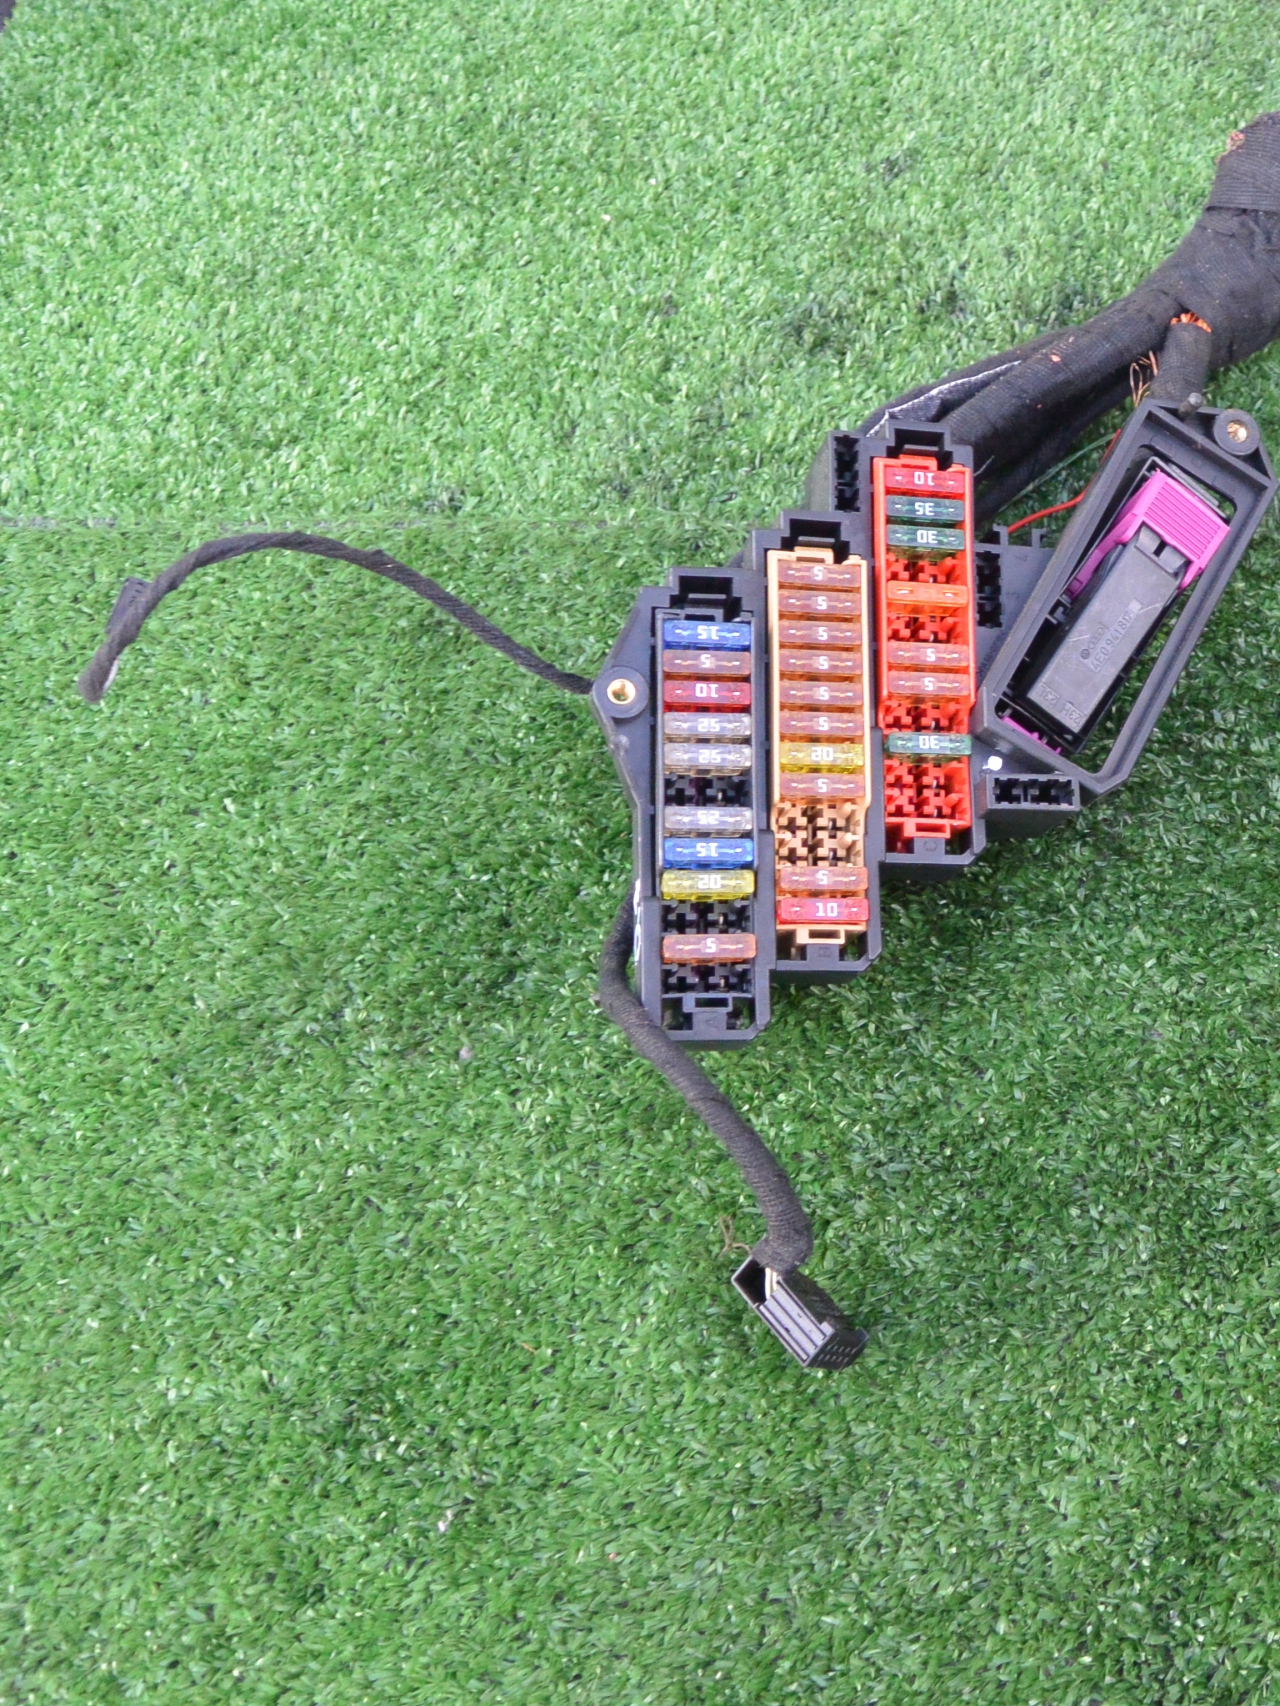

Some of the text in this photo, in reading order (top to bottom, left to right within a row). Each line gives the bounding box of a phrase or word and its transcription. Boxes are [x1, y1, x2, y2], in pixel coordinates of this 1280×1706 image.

[914, 472, 934, 485] 10
[915, 502, 934, 515] 35
[917, 530, 938, 543] 30
[813, 566, 823, 581] 5
[816, 596, 827, 610] 5
[697, 626, 719, 639] 15
[817, 627, 828, 640] 5
[700, 654, 711, 668] 5
[926, 648, 935, 661] 5
[818, 656, 829, 669] 5
[695, 683, 718, 698] 10
[924, 677, 934, 691] 5
[818, 687, 829, 700] 5
[697, 718, 720, 732] 25
[818, 717, 829, 730] 5
[919, 735, 940, 748] 30
[698, 750, 722, 763] 25
[811, 747, 833, 760] 20
[817, 779, 829, 792] 5
[696, 842, 718, 857] 15
[697, 874, 721, 889] 20
[817, 871, 828, 884] 5
[816, 903, 838, 917] 10
[705, 938, 717, 953] 5
